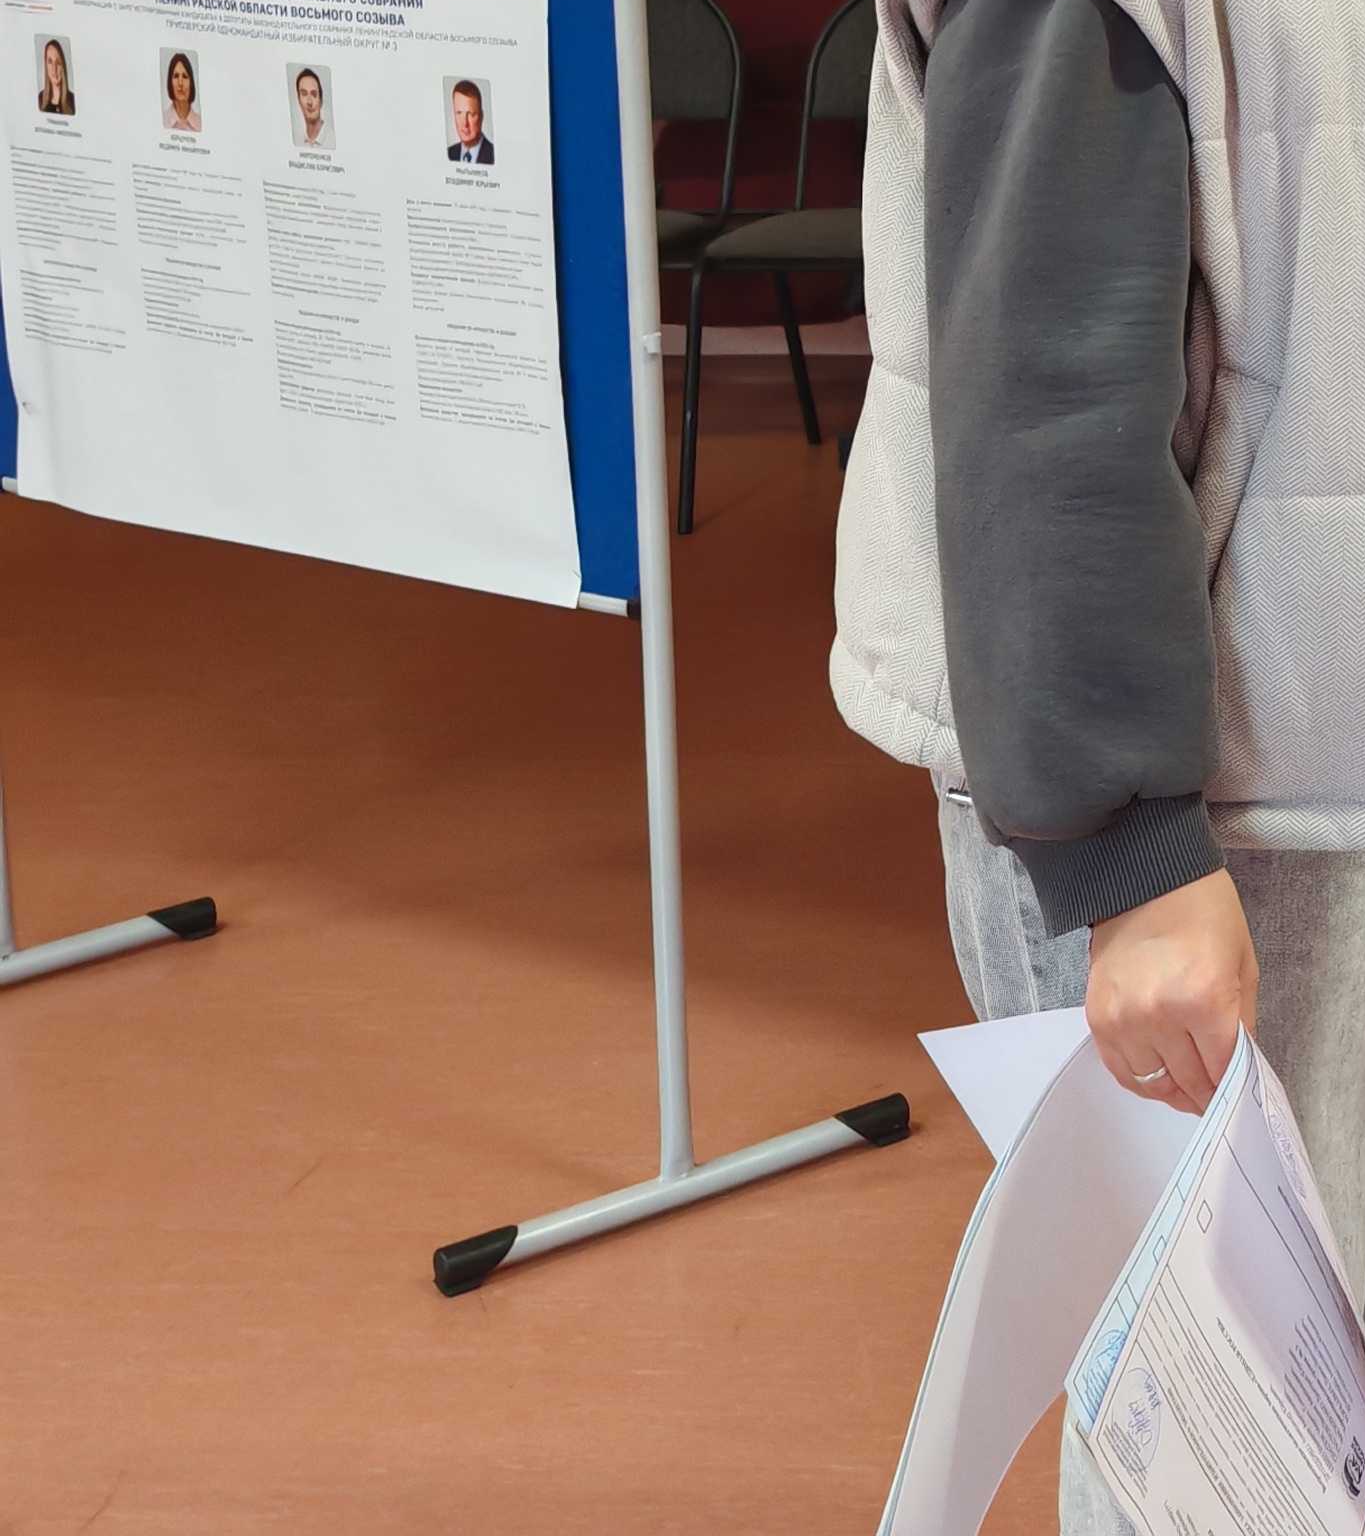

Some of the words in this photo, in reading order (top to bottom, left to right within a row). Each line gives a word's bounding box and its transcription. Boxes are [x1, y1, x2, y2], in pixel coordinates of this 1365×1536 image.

[240, 2, 288, 17] ОБЛАСТИ
[291, 5, 353, 24] ВОСЬМОГО
[356, 12, 405, 27] СОЗЫВА
